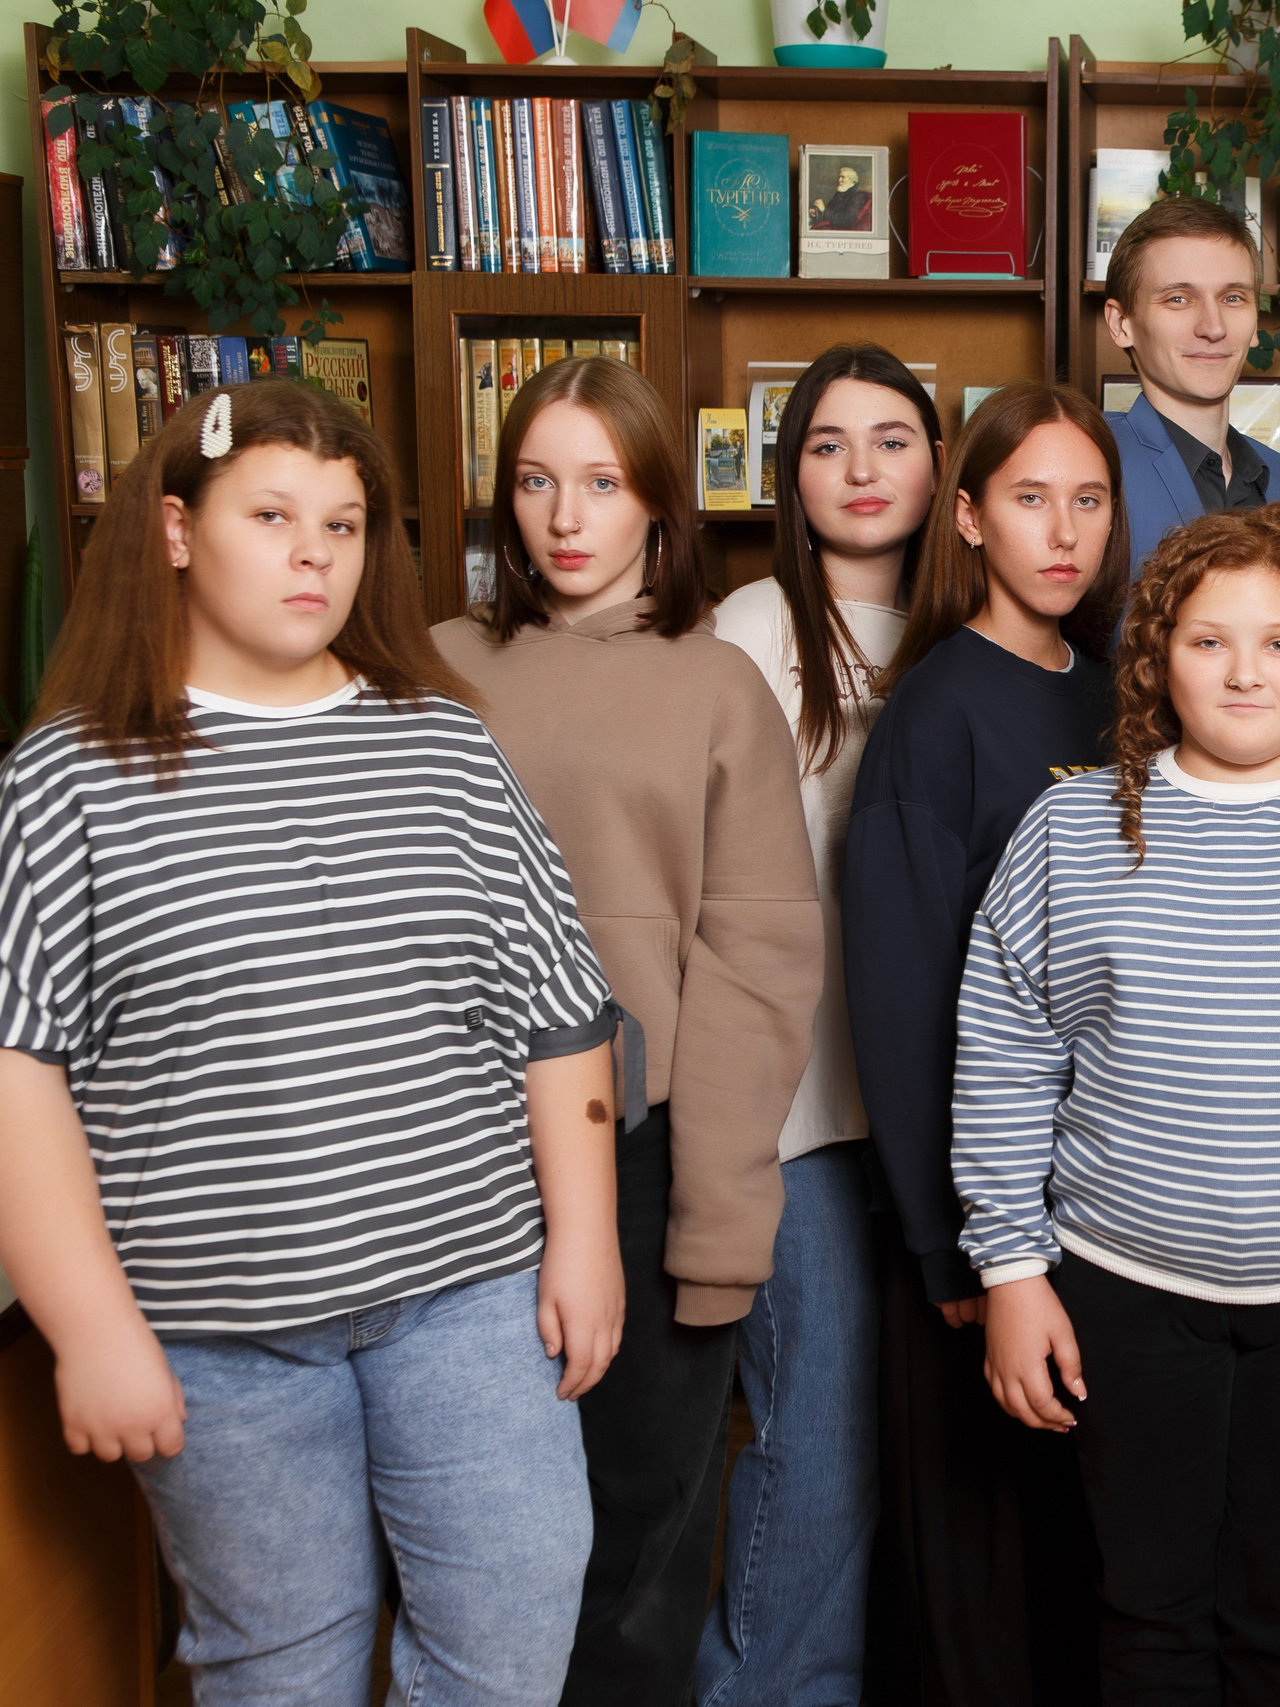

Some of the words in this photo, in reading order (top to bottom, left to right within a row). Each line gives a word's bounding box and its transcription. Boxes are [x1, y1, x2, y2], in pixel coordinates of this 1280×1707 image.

[272, 111, 289, 135] ЕТЕЙ
[536, 104, 545, 131] ДЕТЕЙ
[562, 106, 571, 134] ДЕТЕЙ
[592, 107, 603, 135] ДЕТЕЙ
[615, 107, 626, 135] ДЕТЕЙ
[432, 113, 440, 160] ТЕХНИКА
[521, 138, 529, 155] ДЛЯ
[538, 136, 547, 153] ДЛЯ
[563, 138, 572, 156] ДЛЯ
[597, 139, 607, 156] ДЛЯ
[620, 139, 629, 156] ДЛЯ
[646, 140, 655, 158] ДЛЯ
[56, 140, 67, 162] ДЛЯ
[523, 159, 533, 232] ЭНЦИКЛОПЕДИЯ
[539, 157, 549, 230] ЭНЦИКЛОПЕДИЯ
[600, 160, 616, 233] ЭНЦИКЛОПЕДИЯ
[623, 160, 639, 233] ЭНЦИКЛОПЕДИЯ
[706, 188, 780, 206] ТУРГЕНЕВ
[59, 167, 75, 259] ЭНЦИКЛОПЕДИЯ
[92, 173, 106, 256] ЭНЦИКЛОПЕДИ
[826, 242, 873, 250] ТУРГЕНЕВ
[317, 345, 357, 356] ЦИКЛОПЕДИЯ
[305, 352, 366, 378] РУССКИЙ
[477, 392, 486, 450] ШКОЛЬНАЯ
